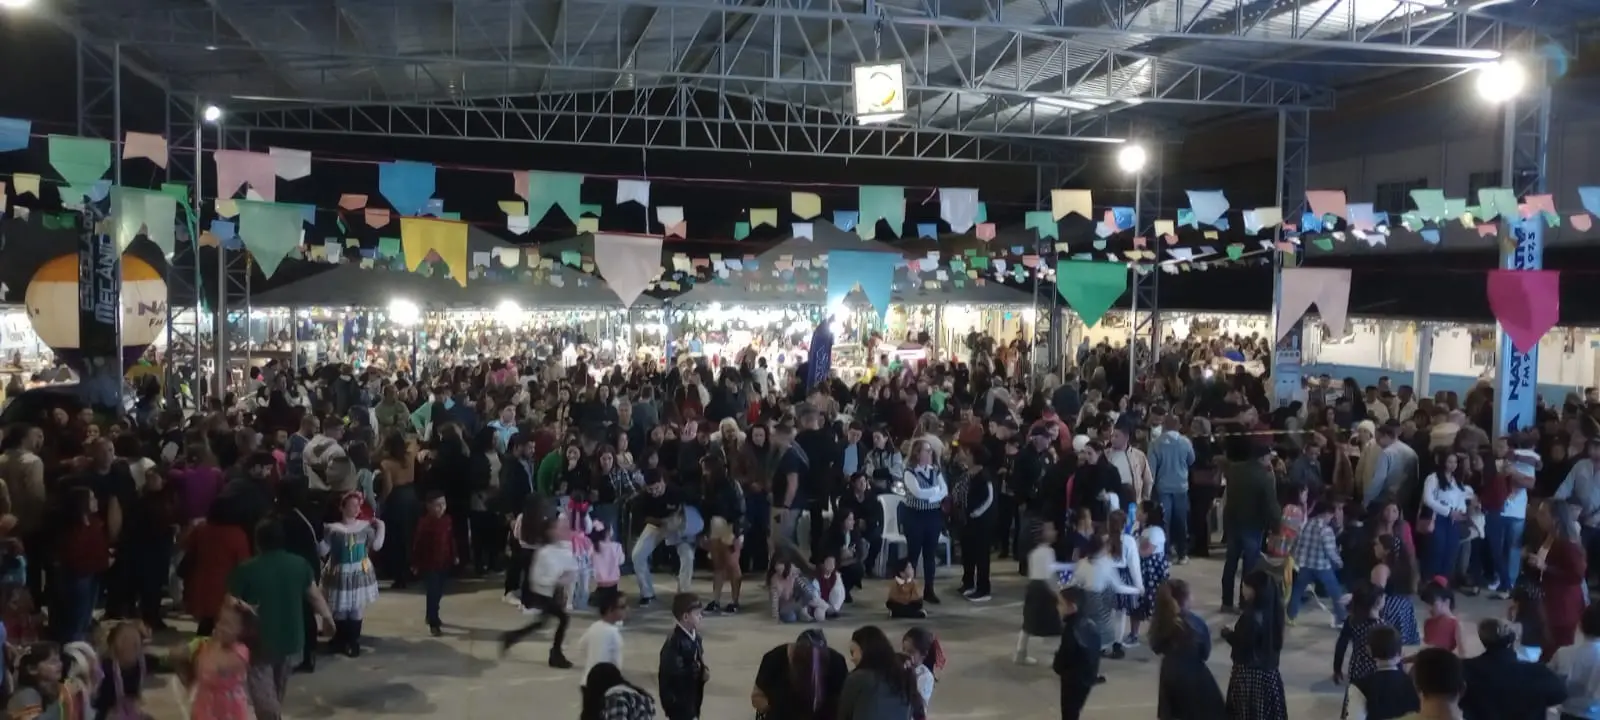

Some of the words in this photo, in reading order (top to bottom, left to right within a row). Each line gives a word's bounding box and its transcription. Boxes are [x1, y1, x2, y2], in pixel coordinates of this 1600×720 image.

[80, 233, 94, 311] ESCOLA
[95, 233, 114, 325] MECÂNIC
[1521, 367, 1531, 388] FM
